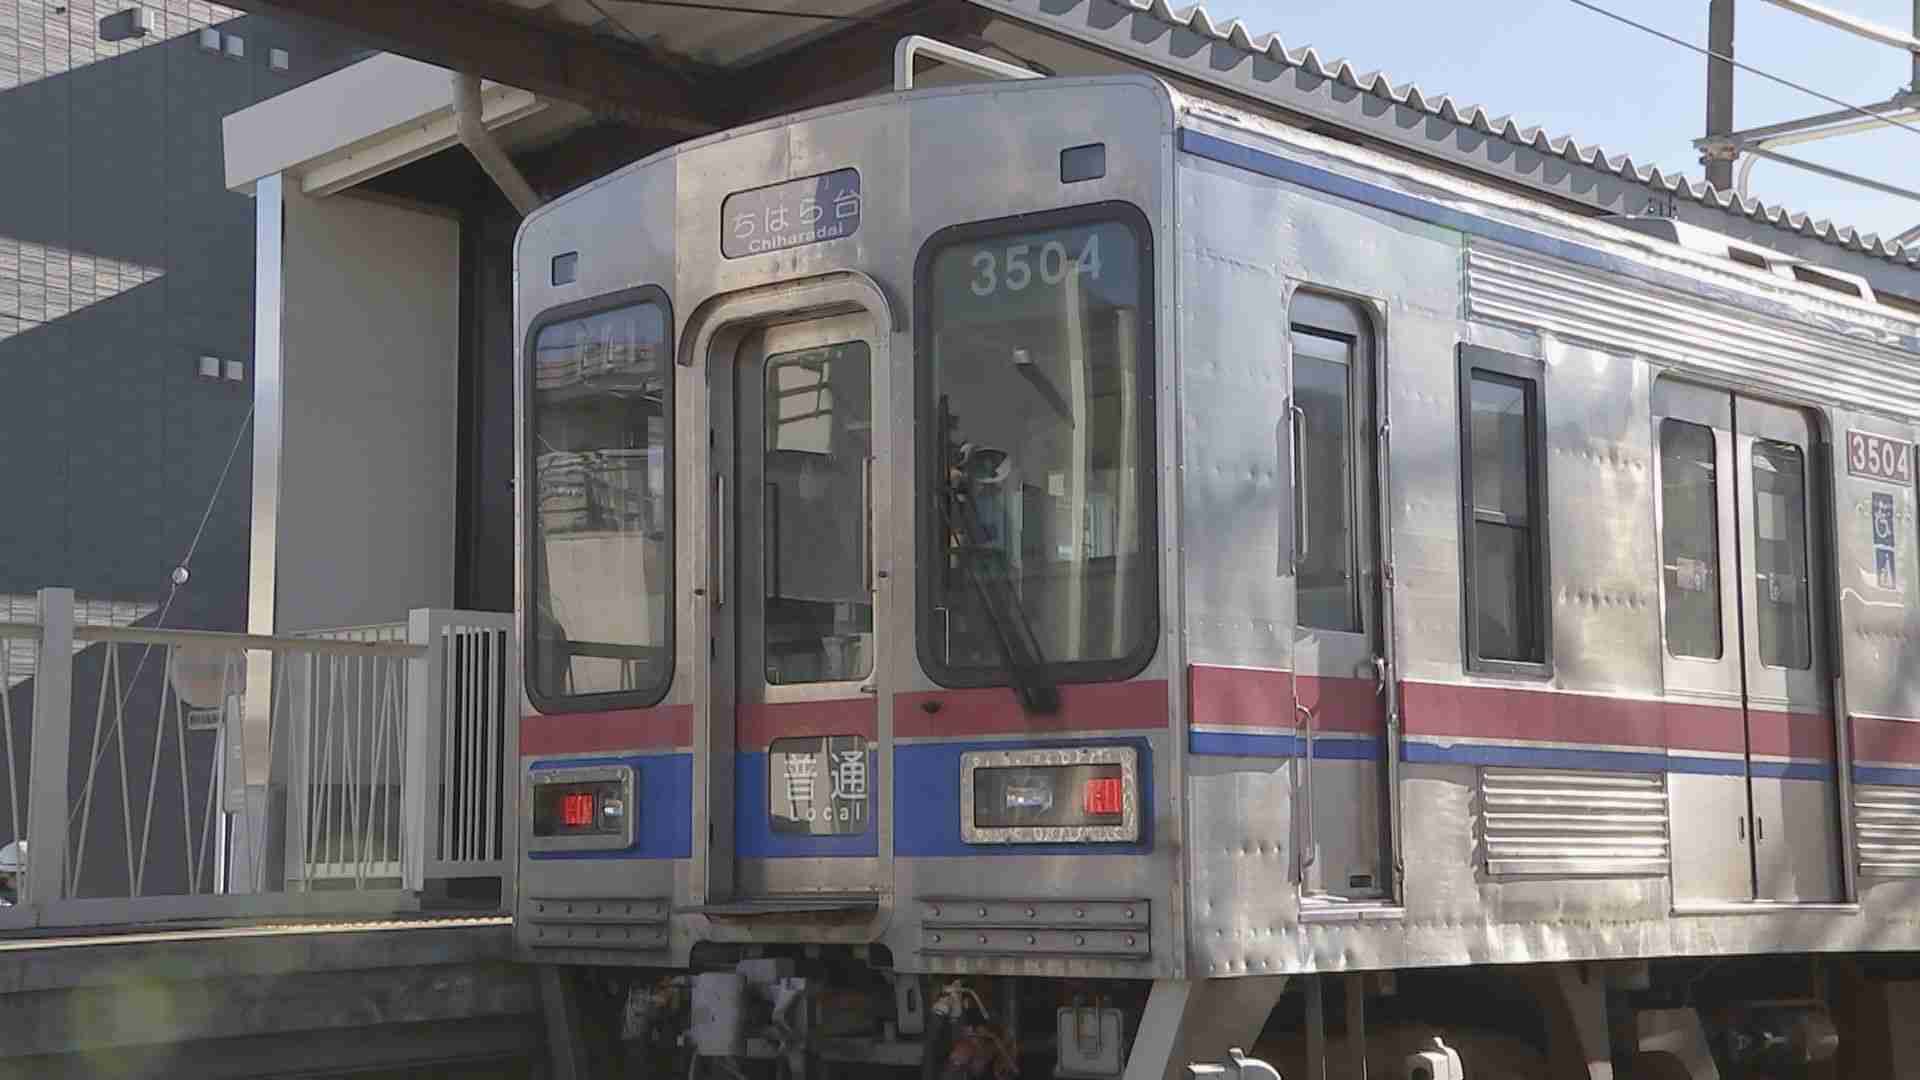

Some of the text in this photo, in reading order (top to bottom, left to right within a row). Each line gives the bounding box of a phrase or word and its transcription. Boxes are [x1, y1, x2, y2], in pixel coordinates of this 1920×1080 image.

[733, 188, 863, 239] ちはら台
[970, 233, 1102, 297] 3504
[1851, 434, 1909, 481] 3504
[784, 751, 867, 800] 普通
[790, 801, 860, 821] Local
